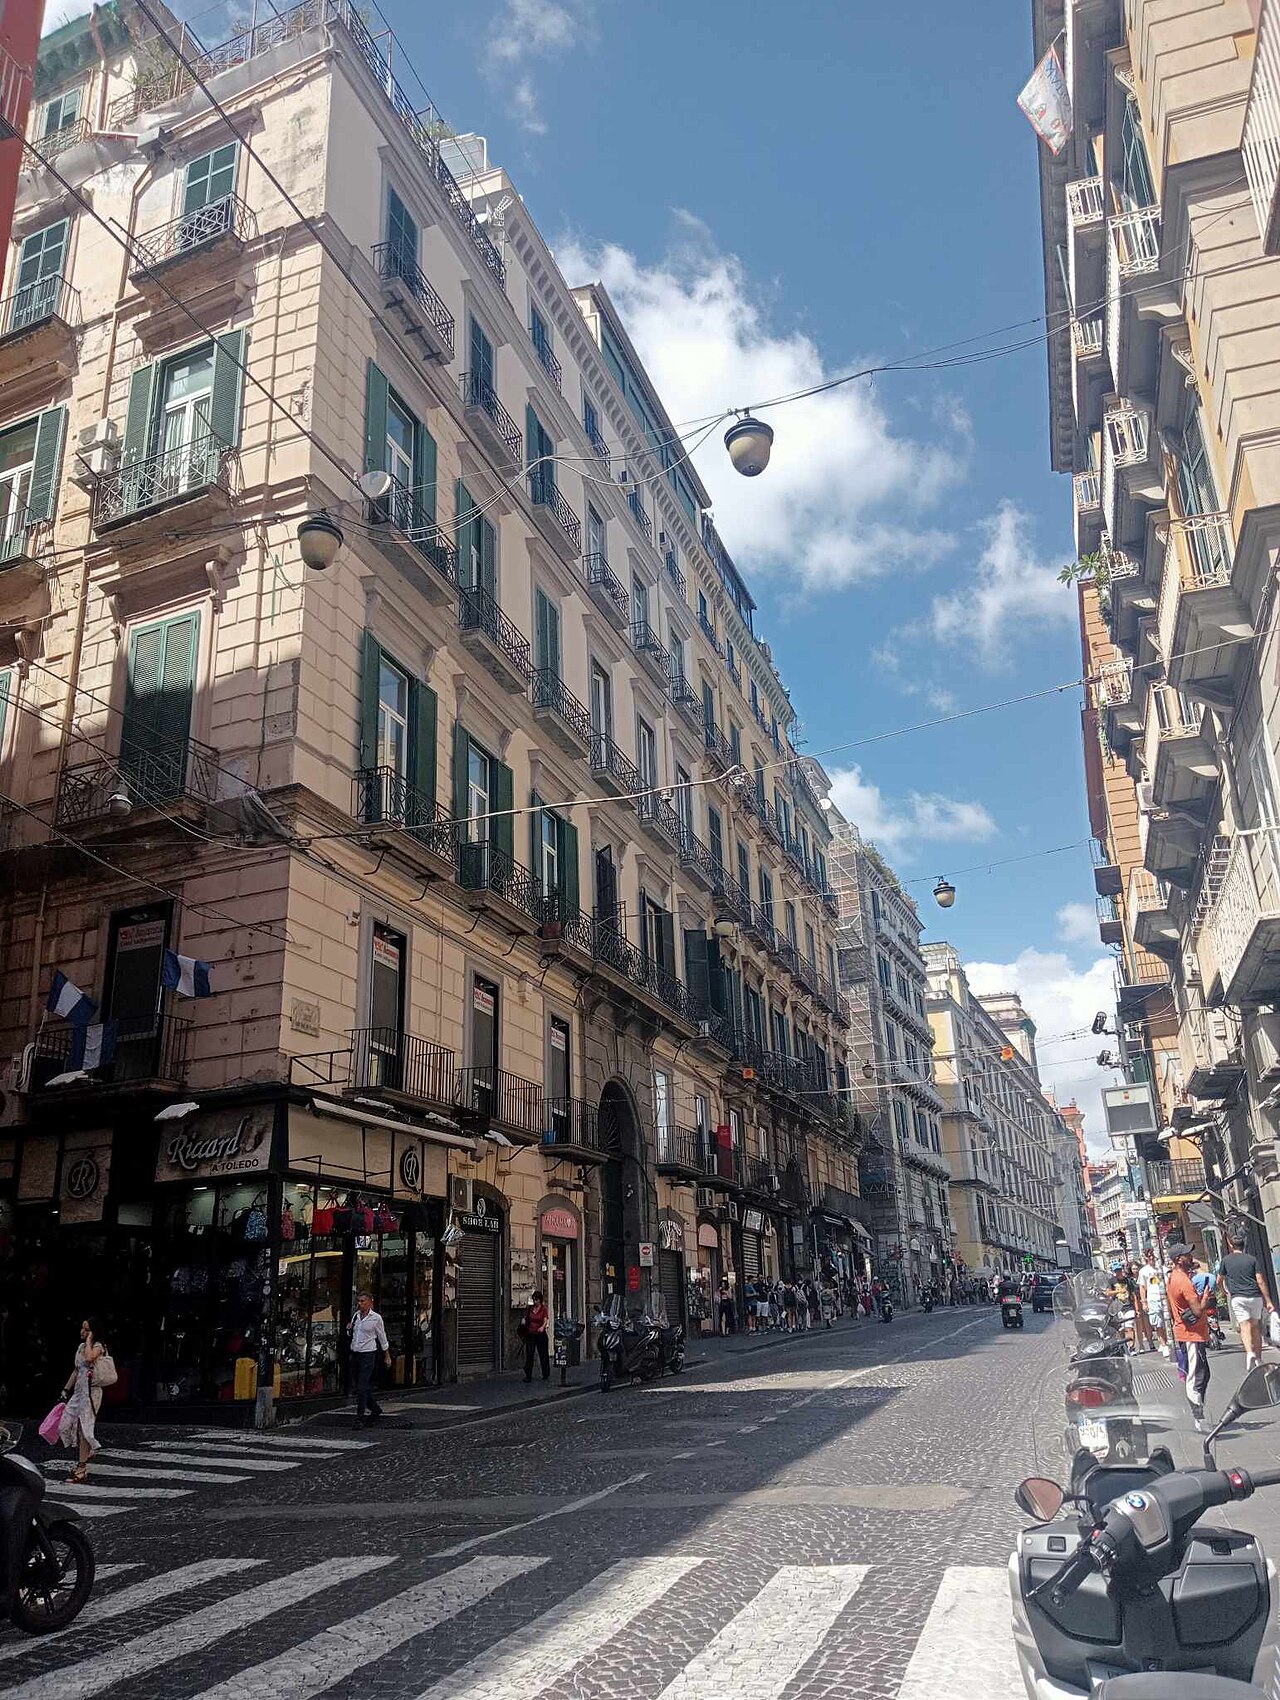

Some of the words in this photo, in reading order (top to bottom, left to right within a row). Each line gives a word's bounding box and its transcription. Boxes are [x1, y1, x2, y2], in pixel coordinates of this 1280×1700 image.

[219, 1158, 259, 1171] TOLEDO
[462, 1216, 483, 1227] SHOE
[484, 1219, 499, 1229] LAB
